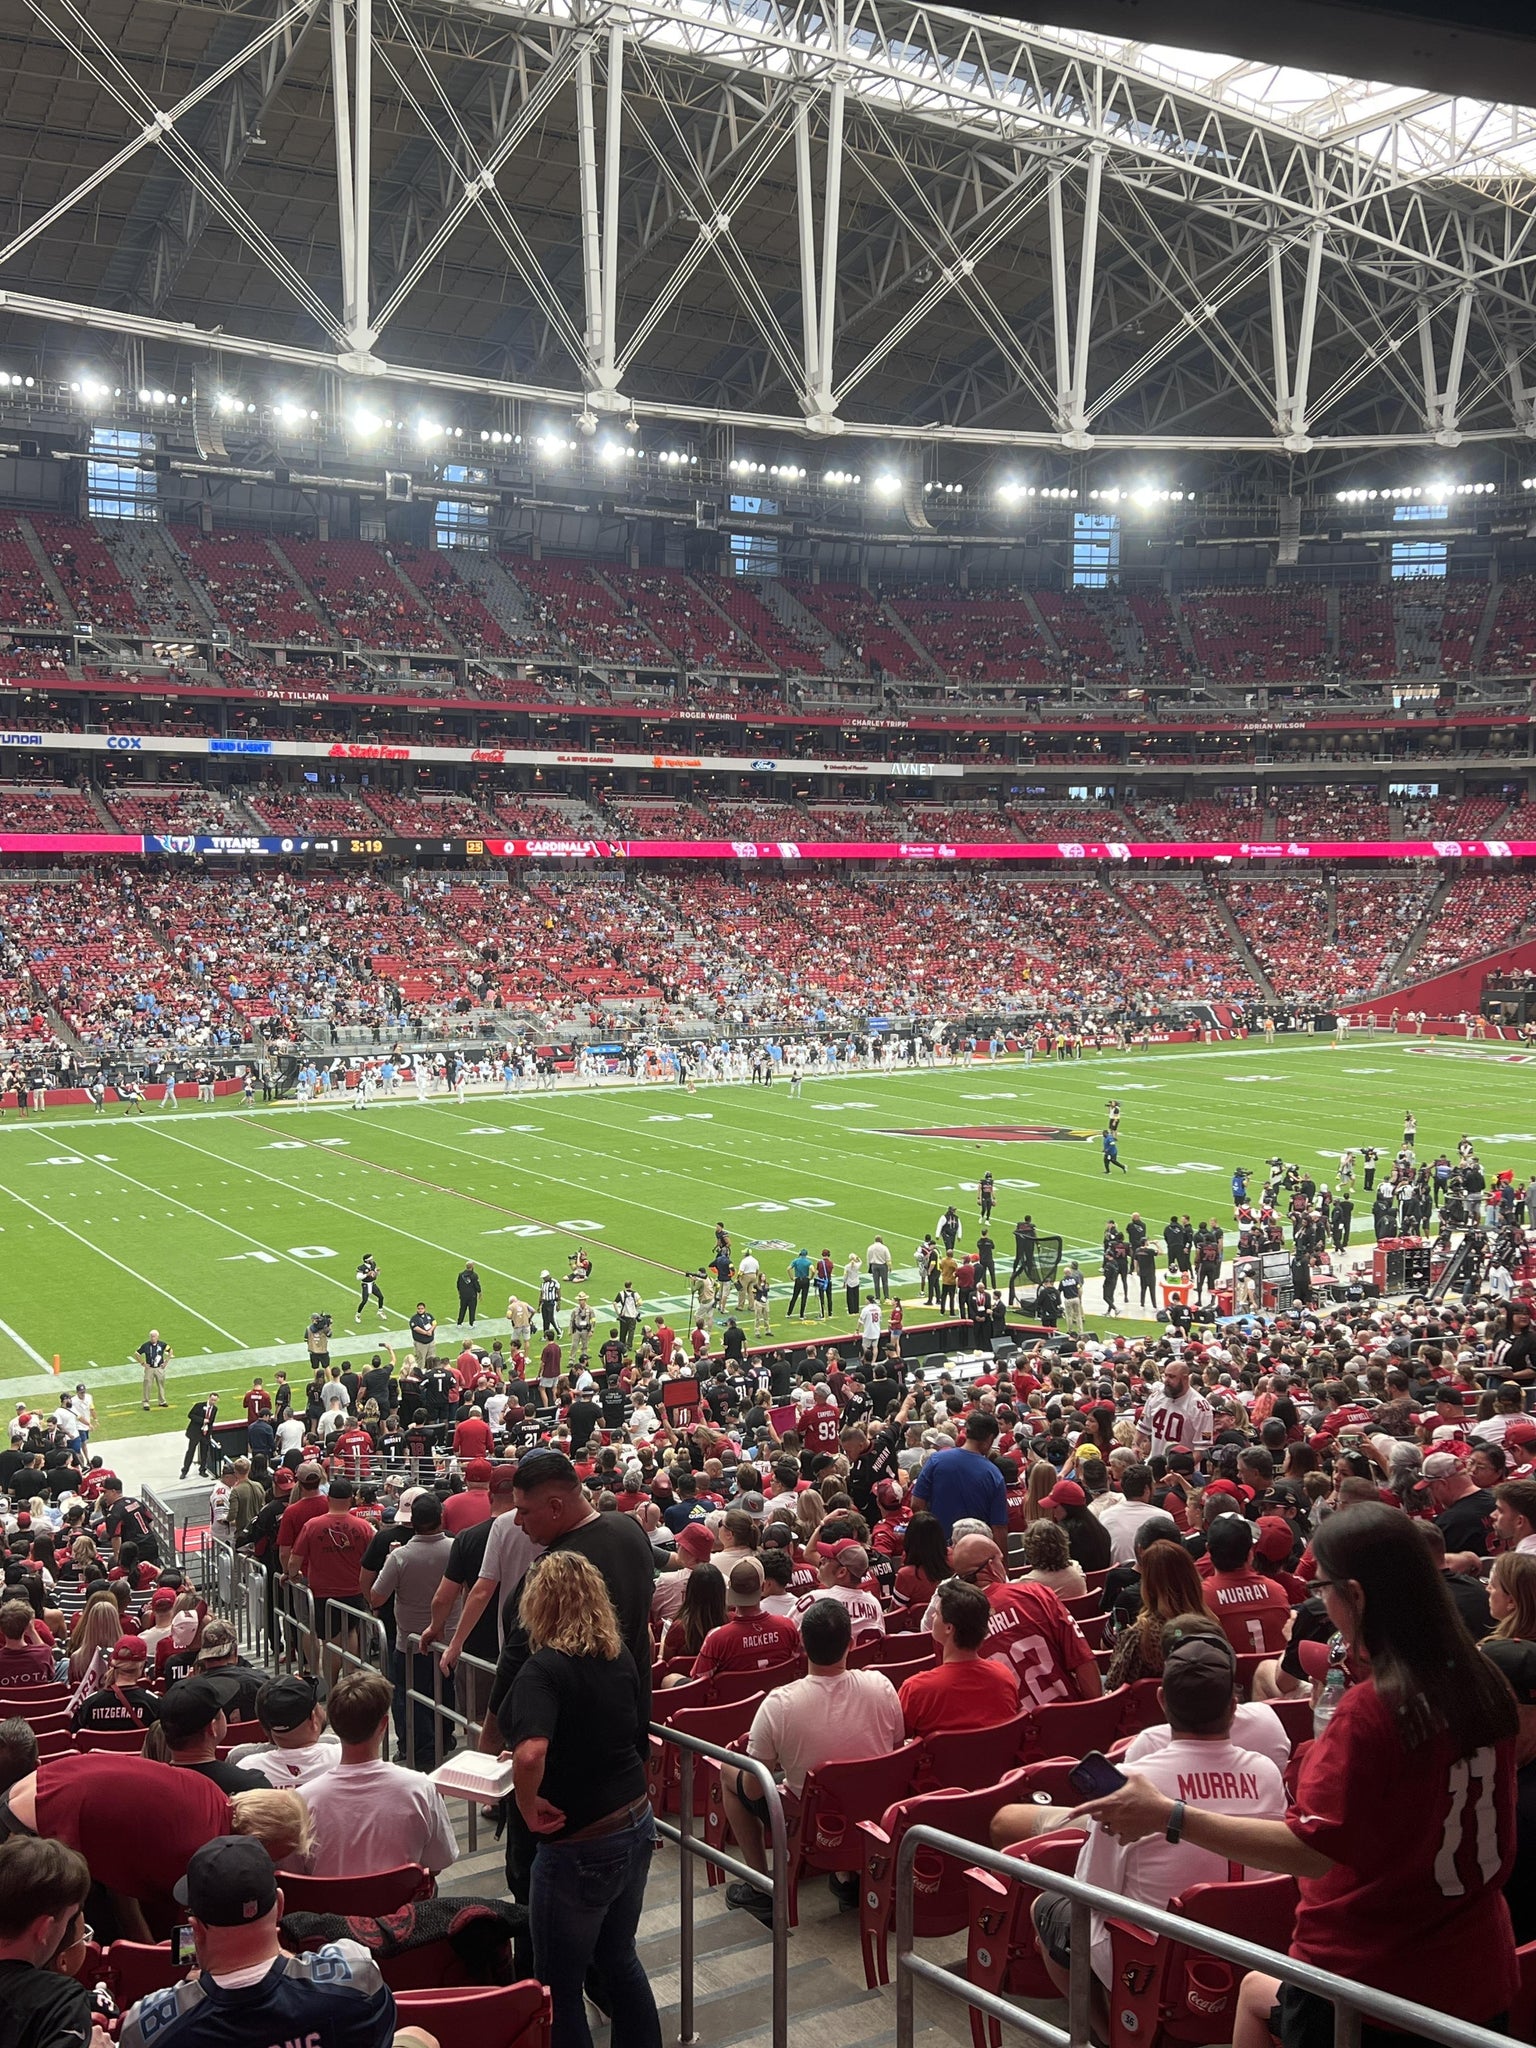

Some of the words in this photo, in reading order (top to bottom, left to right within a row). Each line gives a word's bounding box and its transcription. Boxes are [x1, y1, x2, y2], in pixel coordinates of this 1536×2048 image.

[253, 690, 265, 698] 40
[267, 691, 285, 699] PAT
[288, 692, 329, 700] TILLMAN
[680, 712, 706, 720] ROGER
[852, 719, 884, 727] CHARLEY
[886, 720, 908, 728] TRIPPI
[0, 734, 42, 745] UNDAI
[107, 736, 142, 750] COX
[349, 744, 379, 758] State
[381, 746, 410, 759] Farm
[891, 763, 935, 776] AVNET
[211, 837, 260, 849] TITANS
[281, 838, 293, 852] 0
[351, 840, 383, 852] 3:19
[504, 842, 514, 854] 0
[526, 841, 591, 852] CARDINALS
[269, 1137, 351, 1149] 20
[1137, 1162, 1224, 1175] 50
[741, 1196, 836, 1212] 30
[502, 1219, 606, 1237] 20
[244, 1245, 339, 1264] 10
[871, 1312, 880, 1323] 18
[438, 1379, 443, 1392] 1
[758, 1376, 769, 1390] 10
[254, 1400, 259, 1414] 1
[1196, 1400, 1210, 1412] 40
[680, 1408, 687, 1425] 11
[818, 1421, 837, 1441] 93
[1152, 1407, 1185, 1443] 40
[524, 1433, 538, 1448] 21
[352, 1445, 360, 1460] 11
[390, 1446, 396, 1462] 1
[871, 1446, 892, 1473] MURRAY
[134, 1510, 149, 1535] 1
[1216, 1583, 1270, 1605] MURRAY
[742, 1631, 780, 1649] RACKERS
[1246, 1618, 1266, 1655] 1
[92, 1706, 144, 1720] FITZGERAD
[1177, 1771, 1259, 1801] MURRAY
[1434, 1746, 1502, 1896] 11
[1188, 1990, 1228, 2014] Coca-Cola
[1124, 2014, 1135, 2027] 36
